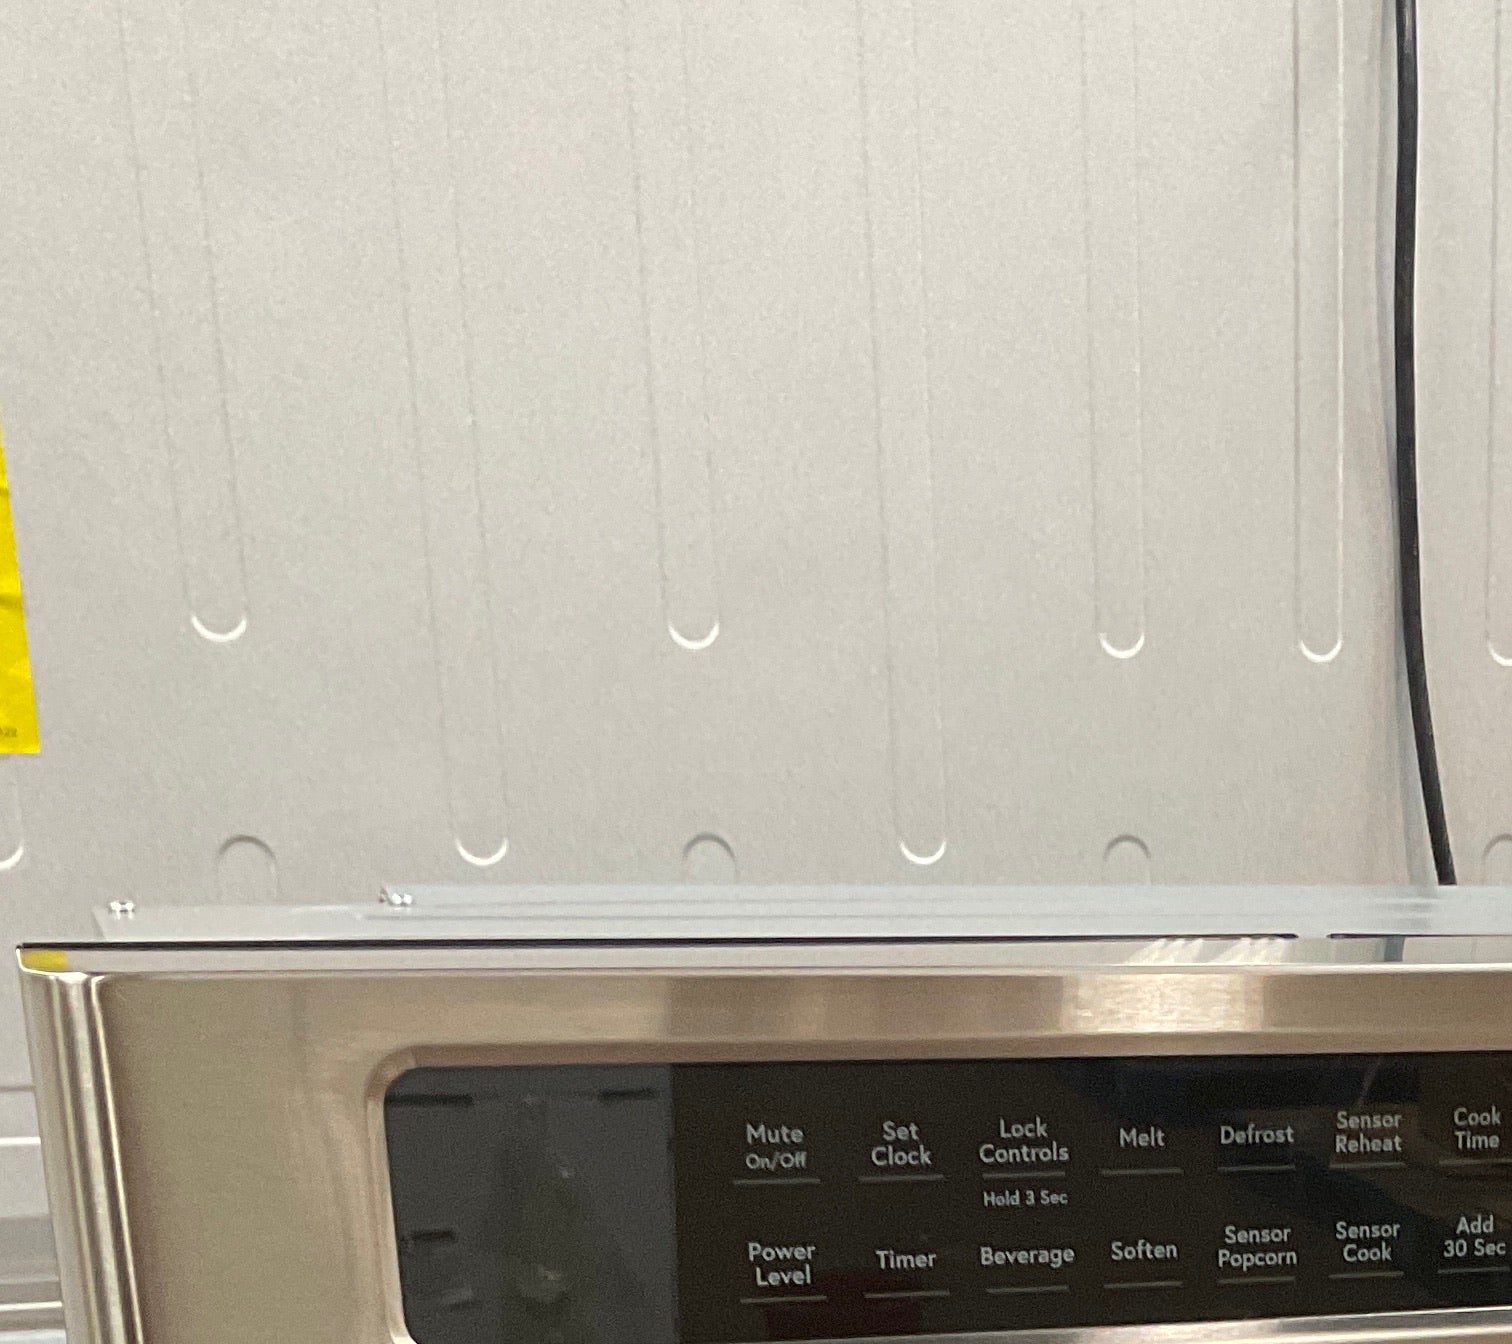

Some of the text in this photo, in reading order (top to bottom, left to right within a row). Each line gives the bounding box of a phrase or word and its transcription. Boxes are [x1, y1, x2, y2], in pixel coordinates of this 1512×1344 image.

[1336, 1110, 1402, 1129] Sensor
[1453, 1105, 1501, 1126] Cook
[746, 1123, 804, 1144] Mute
[882, 1120, 919, 1141] Set
[999, 1116, 1048, 1139] Lock
[1119, 1126, 1165, 1147] Melt
[1220, 1123, 1295, 1145] Defrost
[1335, 1132, 1402, 1153] Reheat
[1454, 1130, 1500, 1149] Time
[745, 1151, 807, 1170] On/Off
[871, 1144, 932, 1166] Clock
[979, 1140, 1069, 1164] Controls
[983, 1189, 1068, 1207] Hold 3 Sec
[1224, 1225, 1291, 1244] Sensor
[1335, 1220, 1401, 1240] Sensor
[1456, 1214, 1494, 1234] Add
[748, 1242, 816, 1262] Power
[980, 1246, 1075, 1269] Beverage
[1111, 1239, 1178, 1261] Soften
[1343, 1241, 1392, 1262] Cook
[1443, 1238, 1506, 1258] 30 Sec
[875, 1250, 937, 1269] Timer
[1218, 1249, 1298, 1272] Popcorn
[755, 1264, 811, 1286] Level
